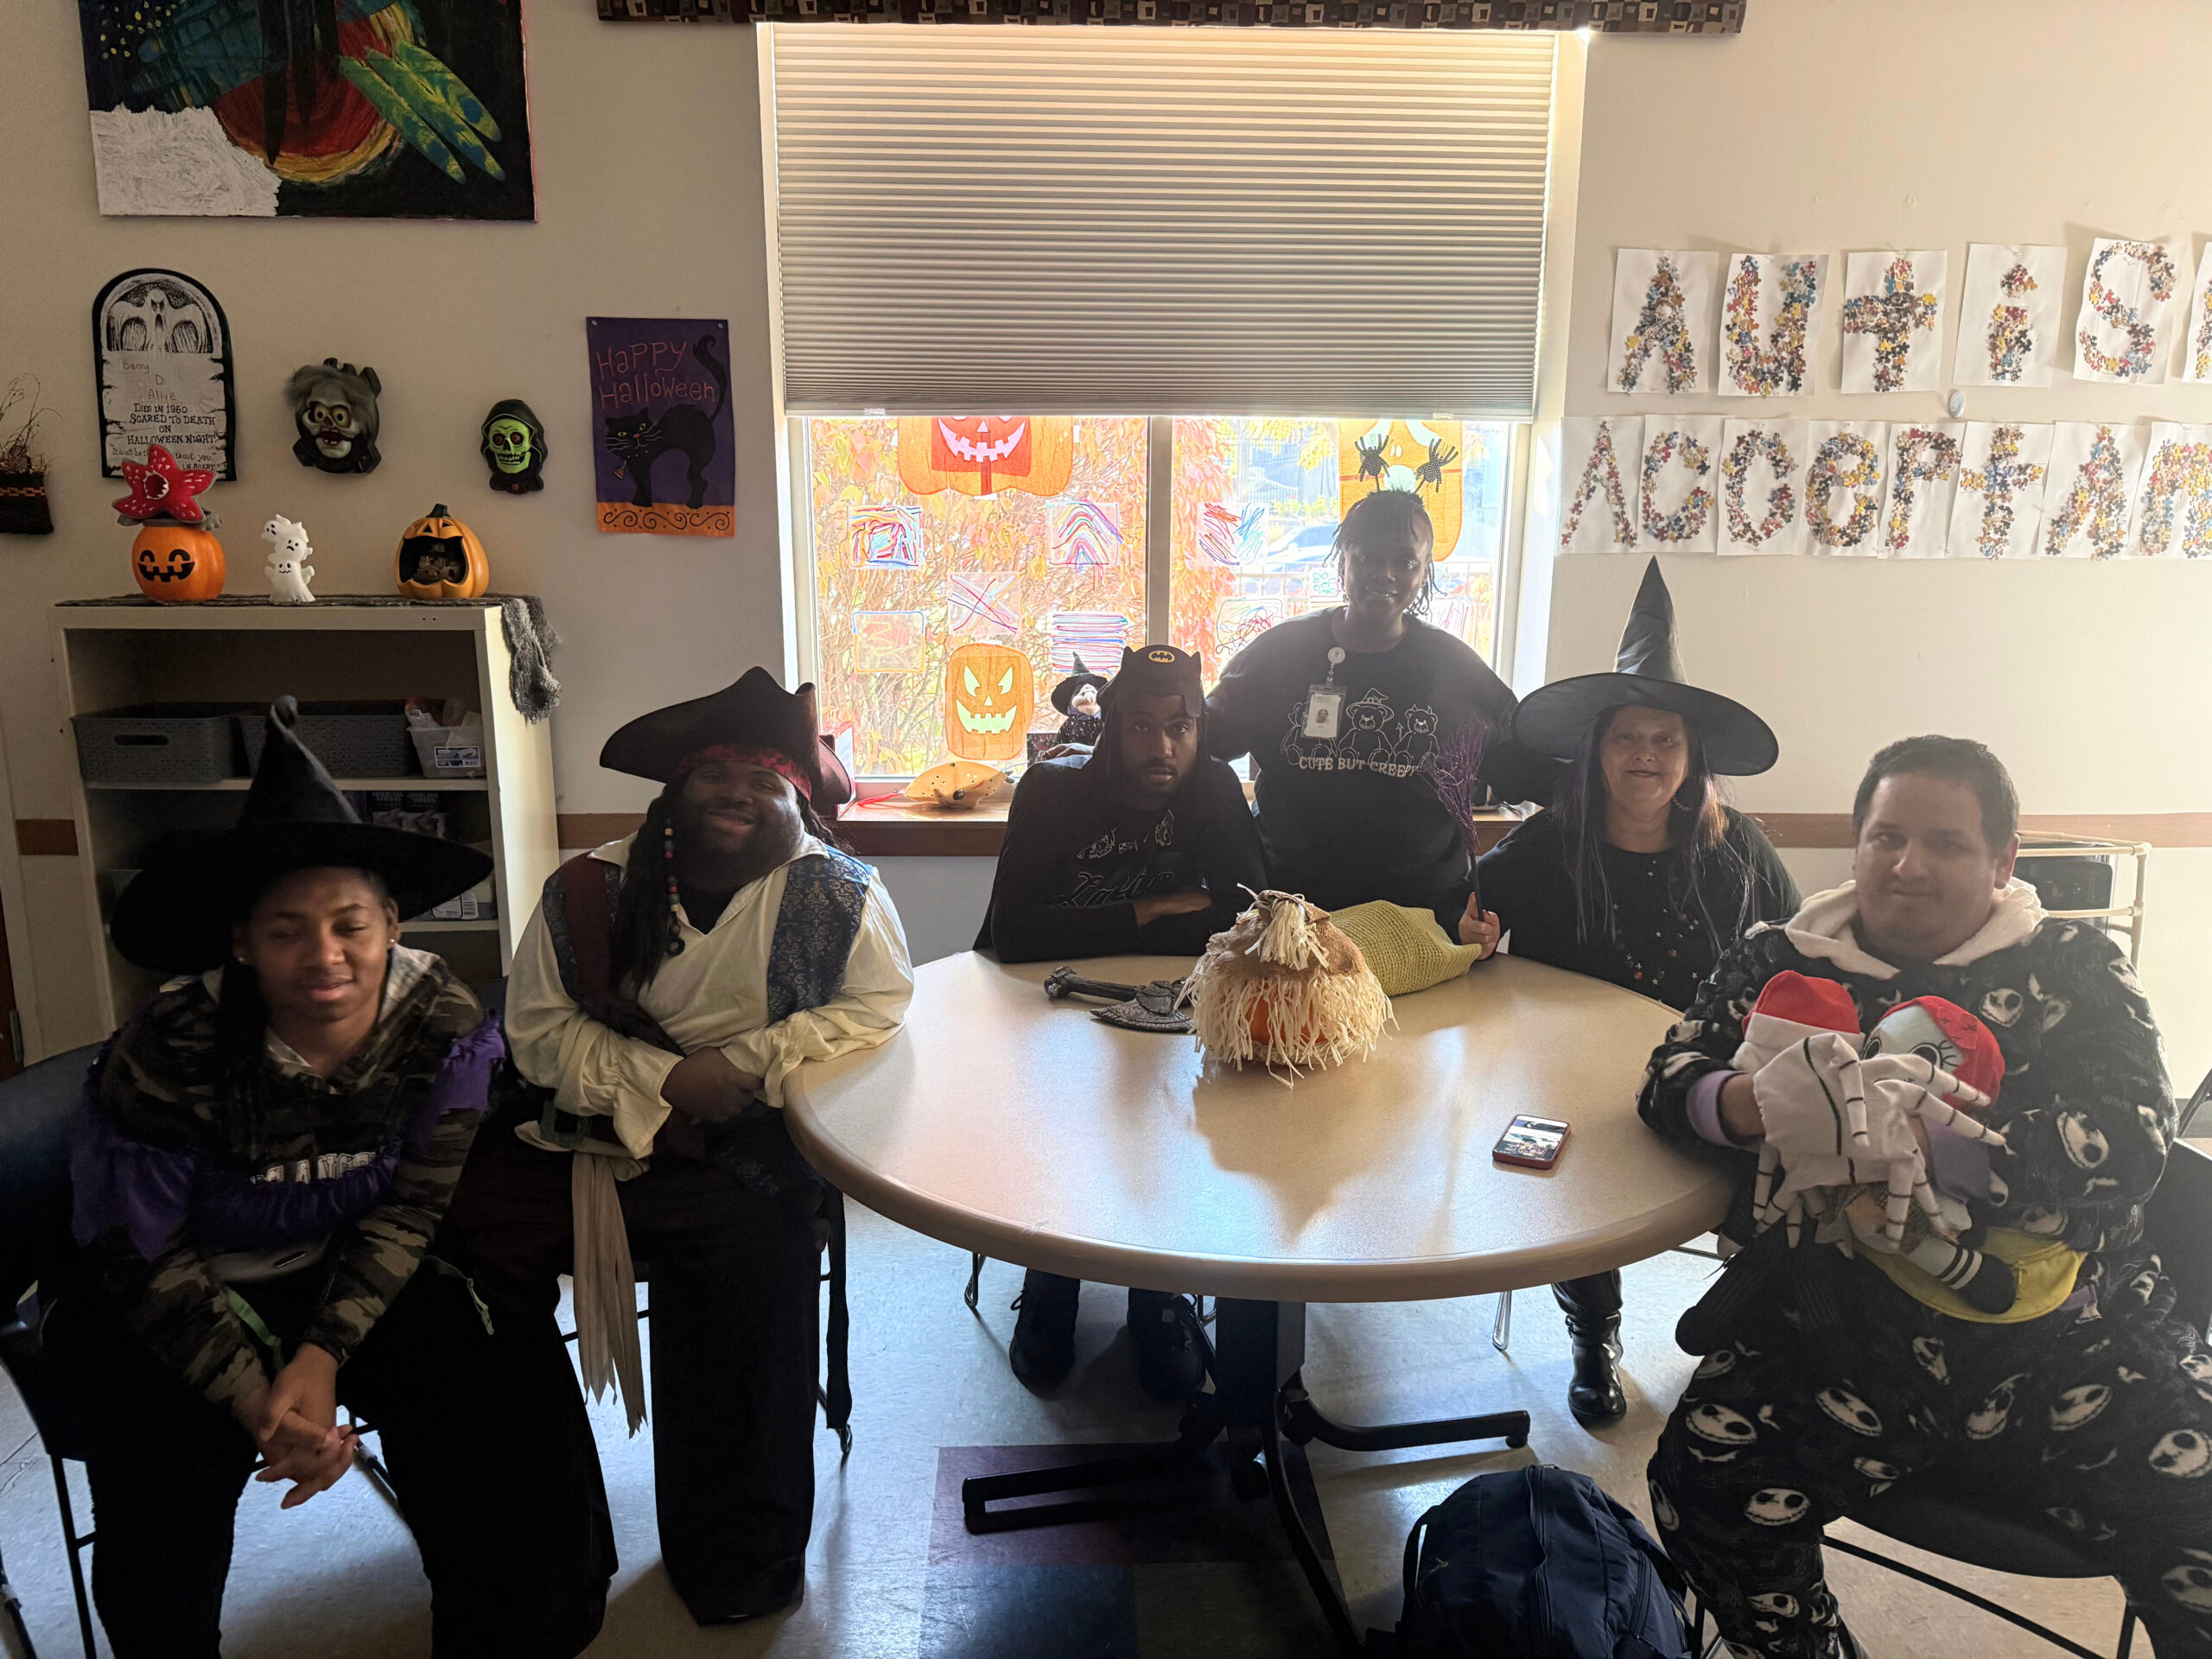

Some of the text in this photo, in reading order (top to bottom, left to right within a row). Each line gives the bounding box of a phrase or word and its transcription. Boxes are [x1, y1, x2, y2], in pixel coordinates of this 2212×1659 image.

[148, 389, 177, 401] Alive
[600, 373, 716, 410] Halloween
[167, 404, 188, 414] 1960
[129, 413, 167, 424] SCARED
[183, 415, 216, 425] DEATH
[1299, 756, 1420, 779] CUTE BUT CREEPY
